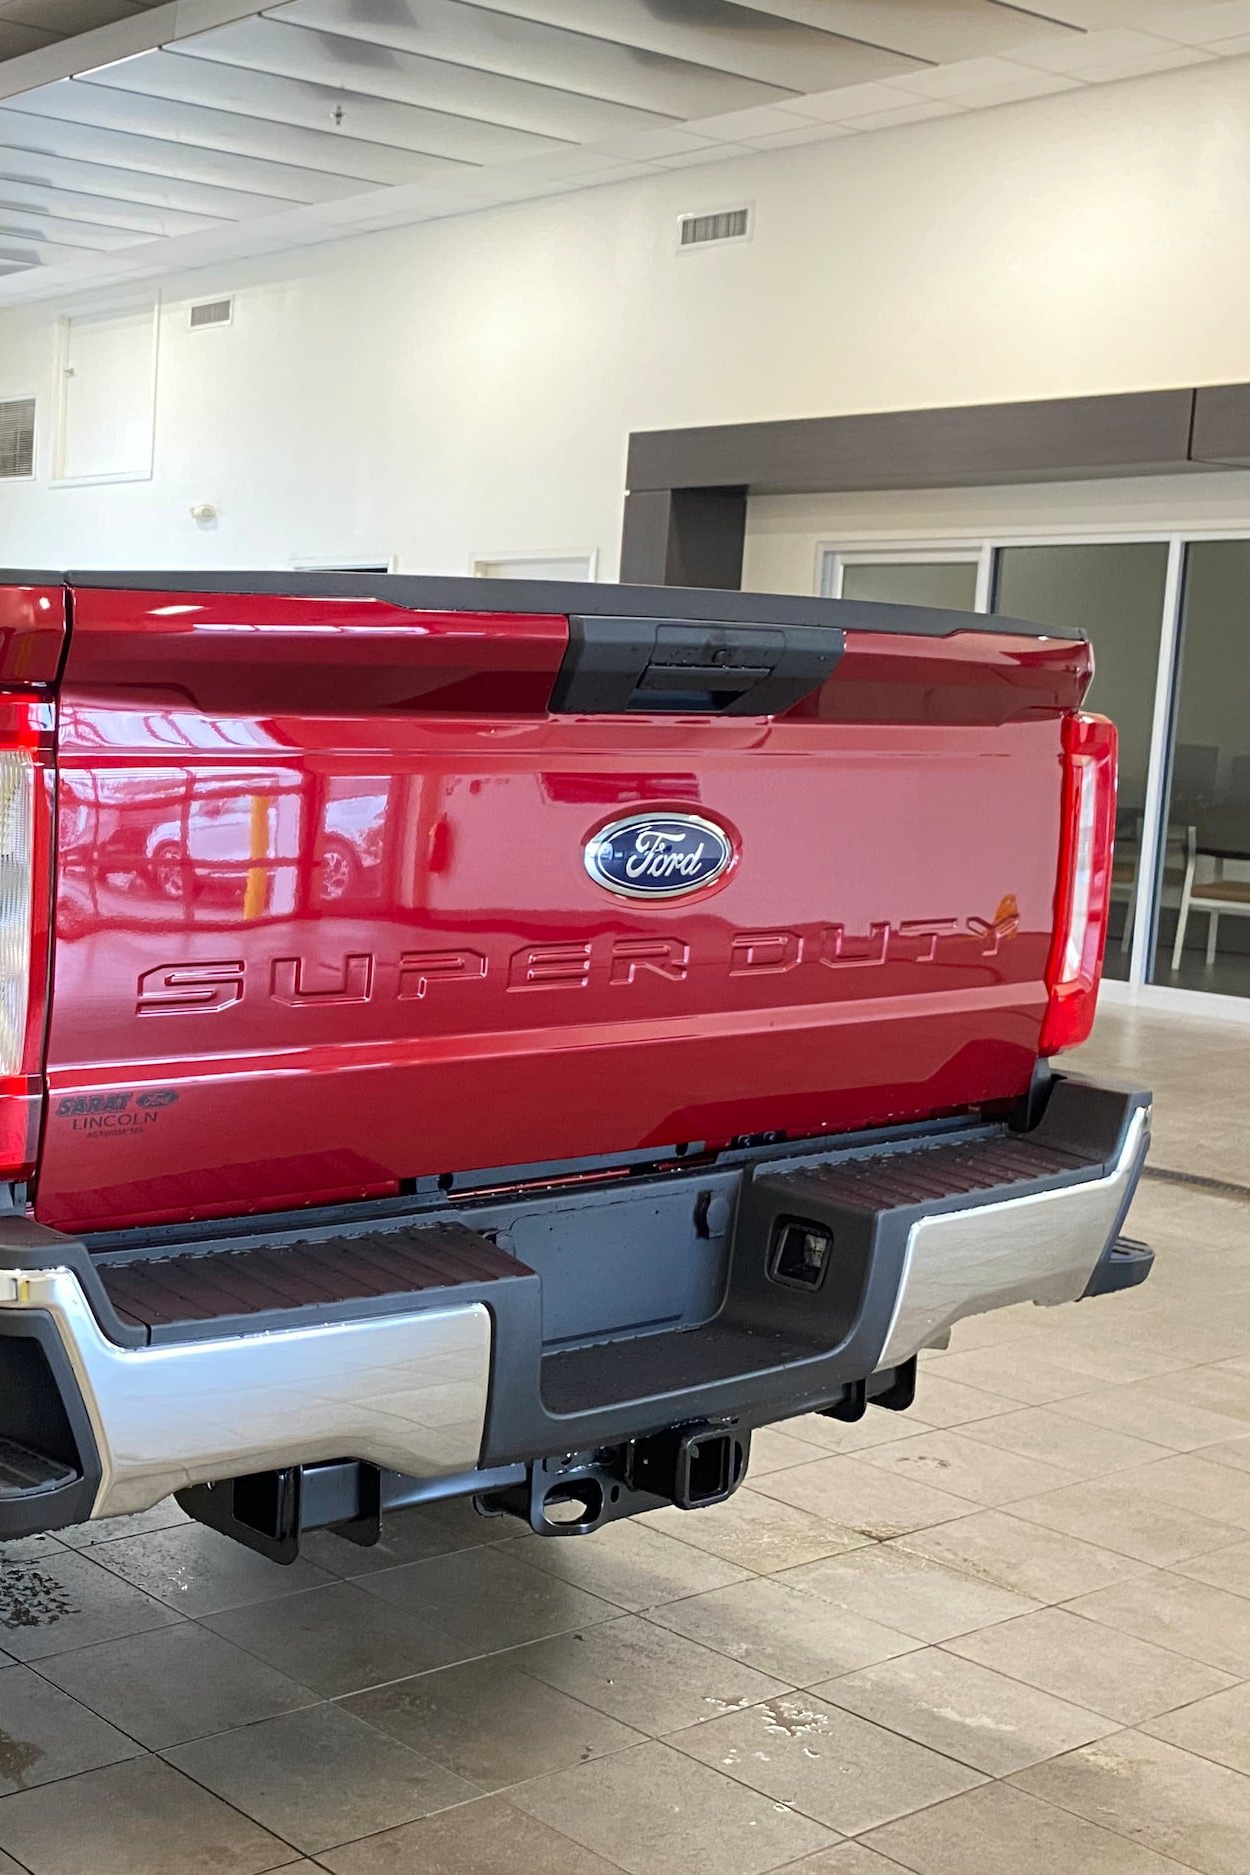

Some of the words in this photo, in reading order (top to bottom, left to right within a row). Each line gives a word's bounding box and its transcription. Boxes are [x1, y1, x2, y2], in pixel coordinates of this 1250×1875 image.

[625, 826, 705, 878] Ford
[136, 936, 690, 1018] SUPER
[729, 913, 1020, 978] DUTY
[56, 1093, 133, 1118] SARAT
[73, 1112, 158, 1130] LINCOLN
